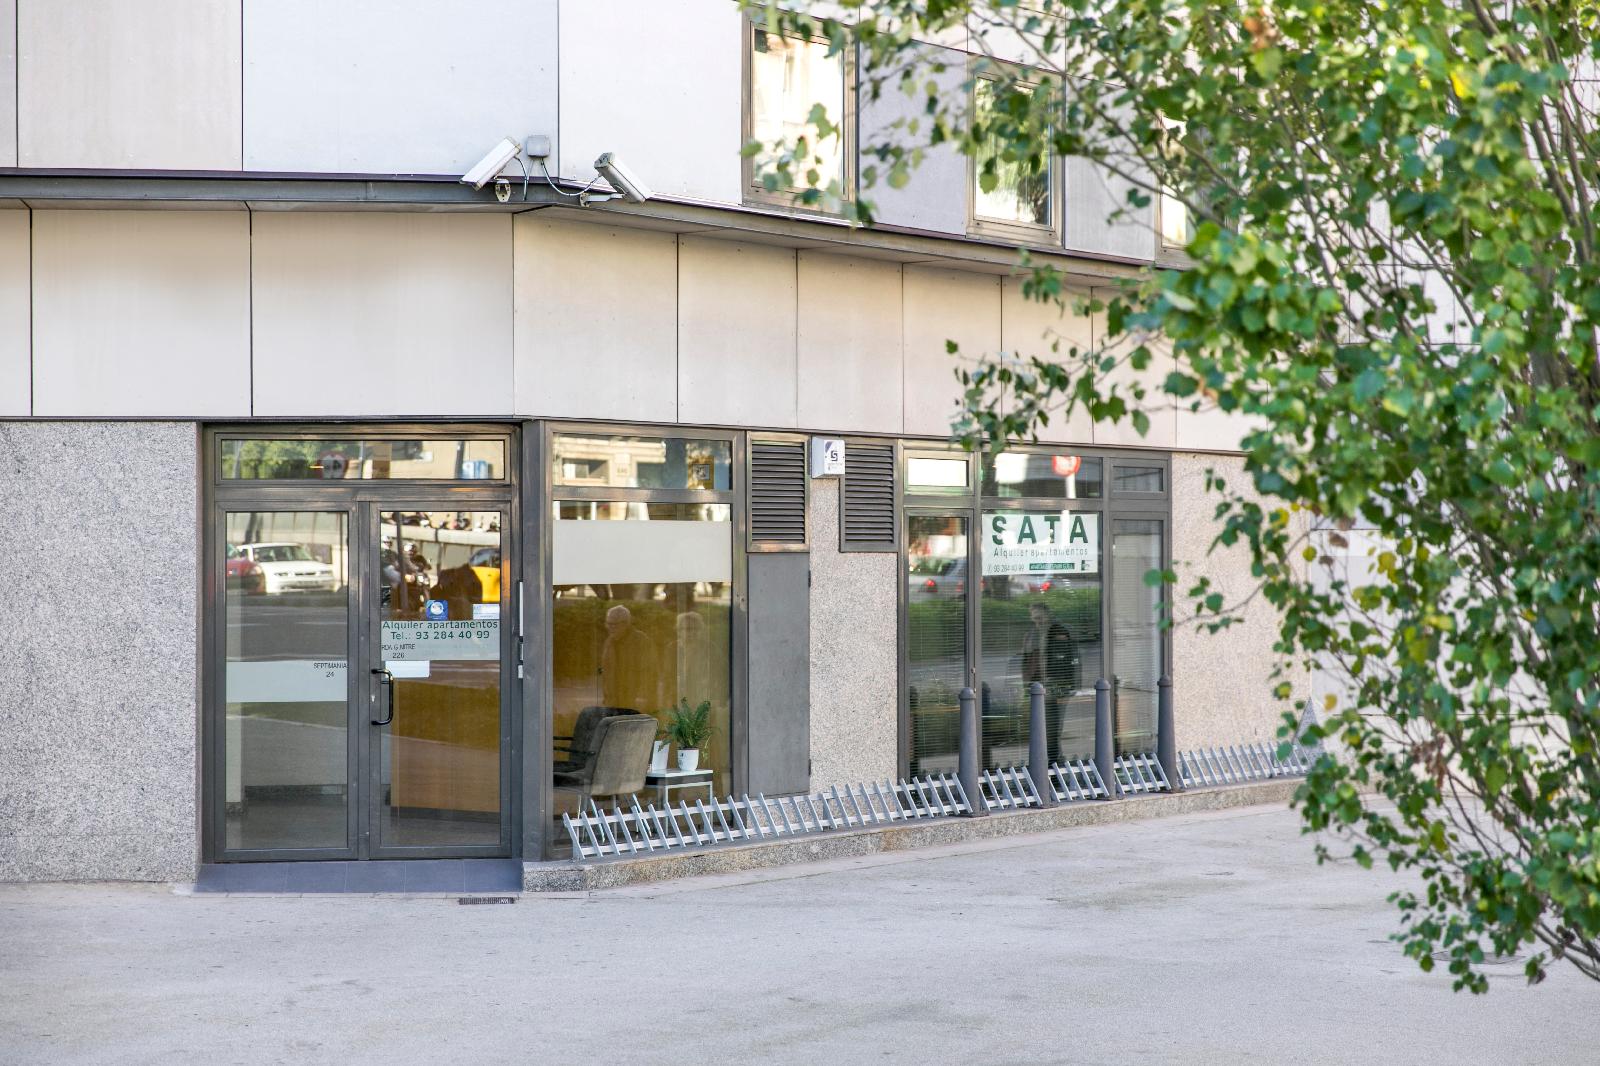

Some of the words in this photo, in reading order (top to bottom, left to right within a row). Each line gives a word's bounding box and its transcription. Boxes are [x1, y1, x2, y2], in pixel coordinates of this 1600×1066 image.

[992, 515, 1088, 545] SATA
[382, 621, 424, 630] Alquiler
[427, 620, 498, 630] apartamentos
[415, 631, 429, 639] 93
[433, 631, 454, 639] 284
[458, 631, 472, 639] 40
[476, 630, 490, 639] 99
